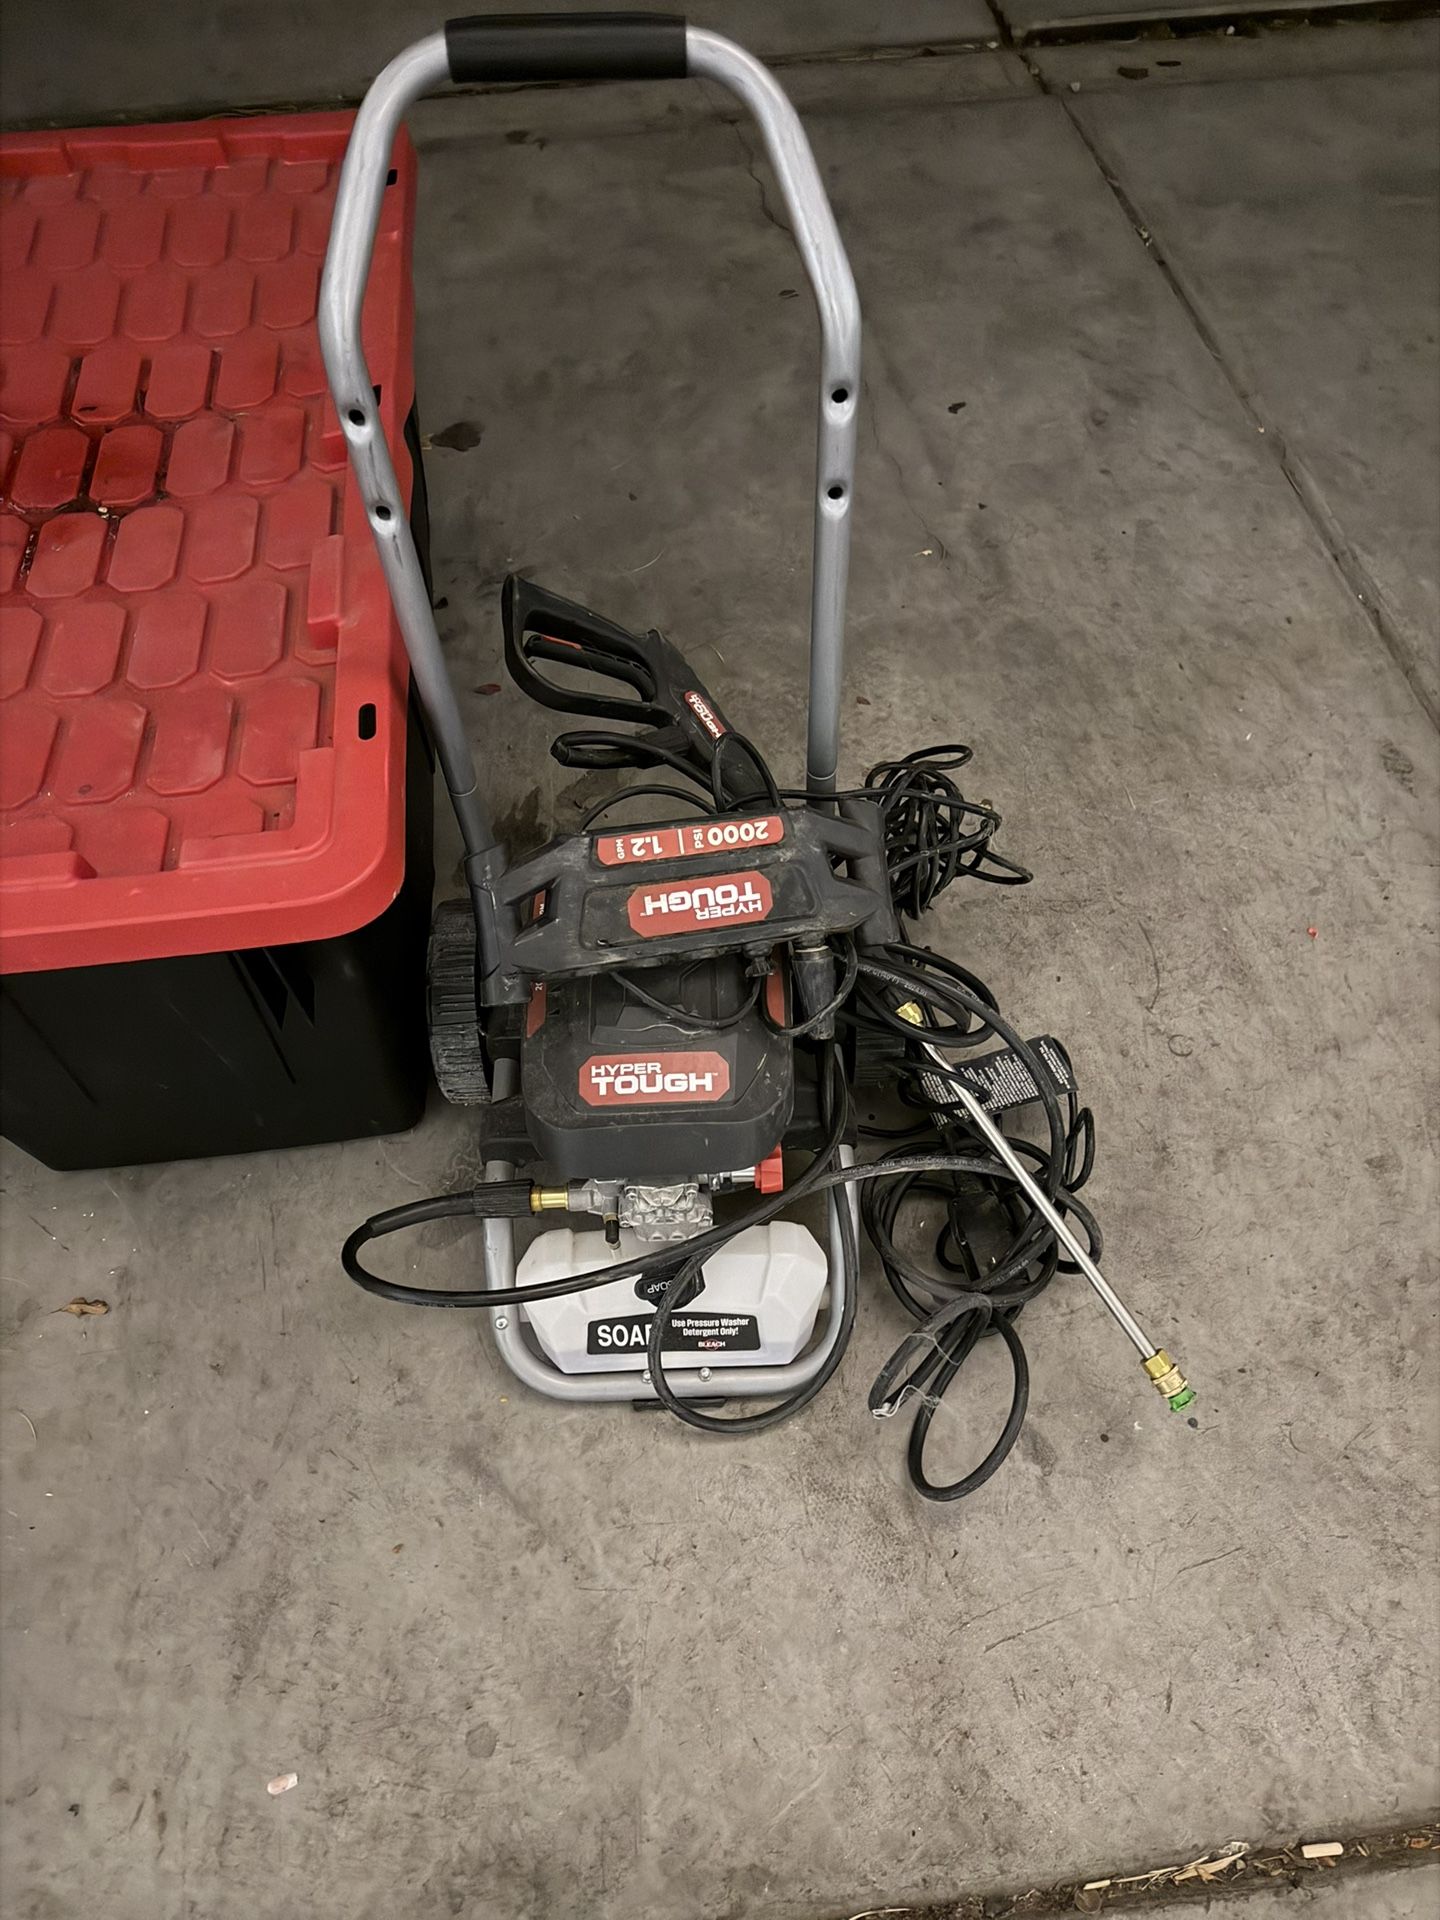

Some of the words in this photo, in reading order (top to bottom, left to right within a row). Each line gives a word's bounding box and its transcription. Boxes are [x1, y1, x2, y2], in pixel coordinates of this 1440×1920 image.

[693, 828, 704, 849] PSI
[707, 821, 769, 846] 2000
[630, 835, 663, 857] 1.2
[643, 881, 761, 916] TOUGH
[695, 900, 763, 920] HYPER
[591, 1062, 662, 1077] HYPER
[591, 1072, 713, 1096] TOUGH
[671, 1319, 686, 1328] Use
[686, 1318, 720, 1328] Pressure
[720, 1317, 750, 1327] Washer
[682, 1327, 719, 1337] Detergent
[720, 1326, 739, 1337] Only!
